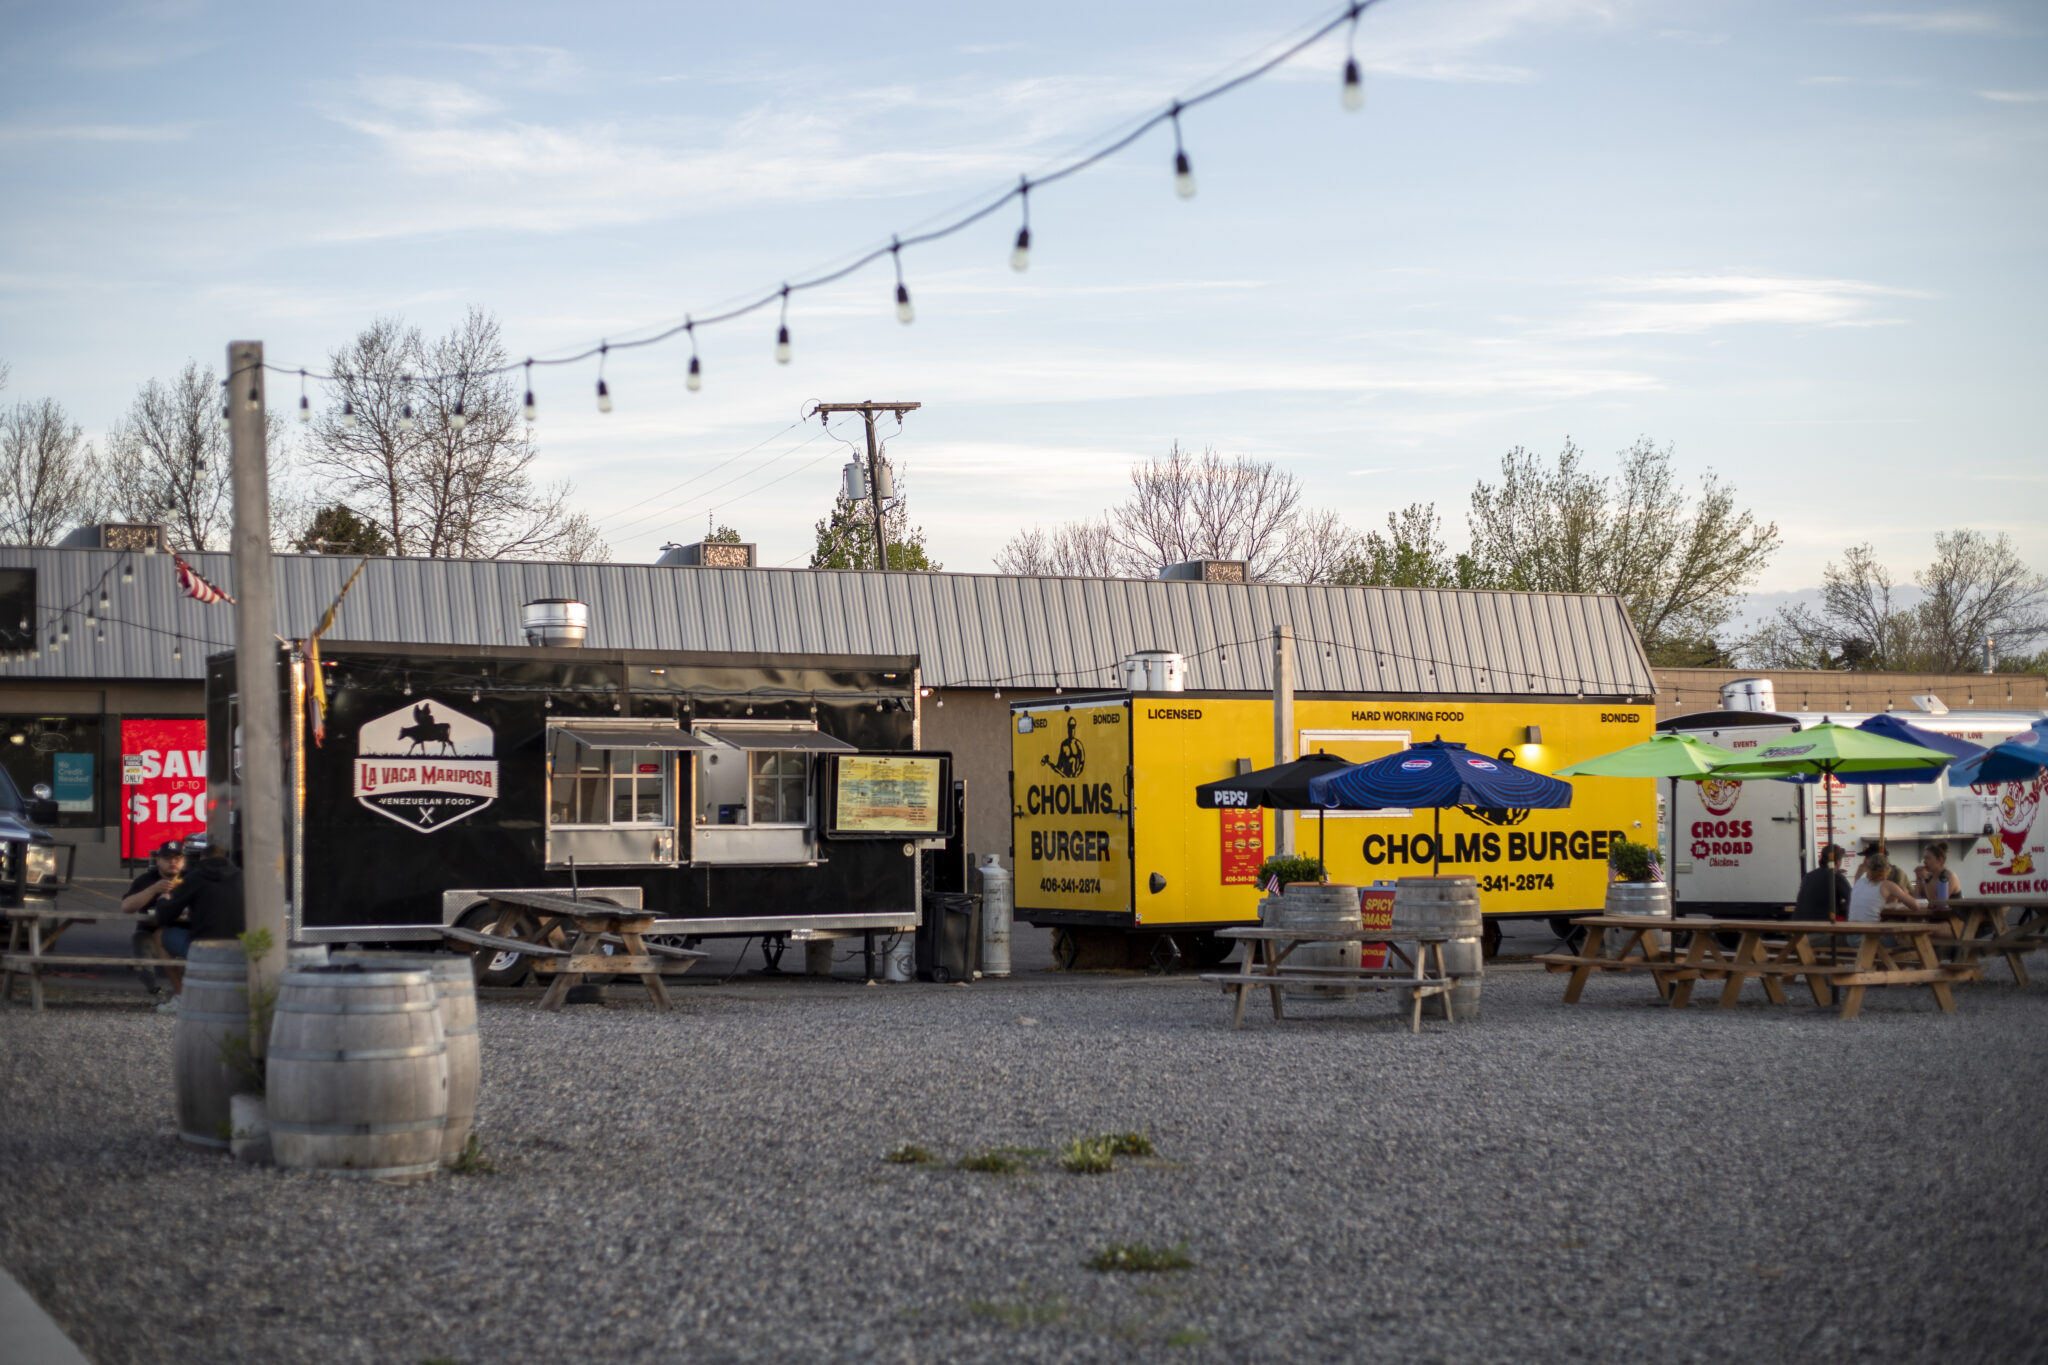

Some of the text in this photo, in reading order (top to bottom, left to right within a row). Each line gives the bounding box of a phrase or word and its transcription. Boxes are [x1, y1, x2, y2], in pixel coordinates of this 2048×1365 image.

[1093, 713, 1120, 725] BONDED
[1148, 709, 1202, 720] LICENSED
[1351, 711, 1464, 722] HARD WORKING FOOD
[1600, 713, 1640, 724] BONDED
[1967, 732, 1983, 740] LOVE
[140, 749, 207, 778] SAV
[58, 768, 83, 776] Credit
[124, 774, 141, 783] ONLY
[361, 764, 493, 791] LA VACA MARIPOSA
[381, 797, 442, 805] VENEZUELAN
[1027, 783, 1113, 815] CHOLMS
[1214, 790, 1248, 806] PEPSI
[1691, 820, 1753, 838] CROSS
[1031, 830, 1111, 862] BURGER
[1363, 833, 1500, 865] CHOLMS
[1712, 842, 1753, 855] ROAD
[1709, 858, 1734, 868] Chicken
[1040, 878, 1101, 894] 406-341-2874
[1477, 874, 1554, 893] -341-2874
[1979, 880, 2031, 895] CHICKEN
[1365, 898, 1394, 911] SPICY
[1362, 913, 1392, 926] SMASH
